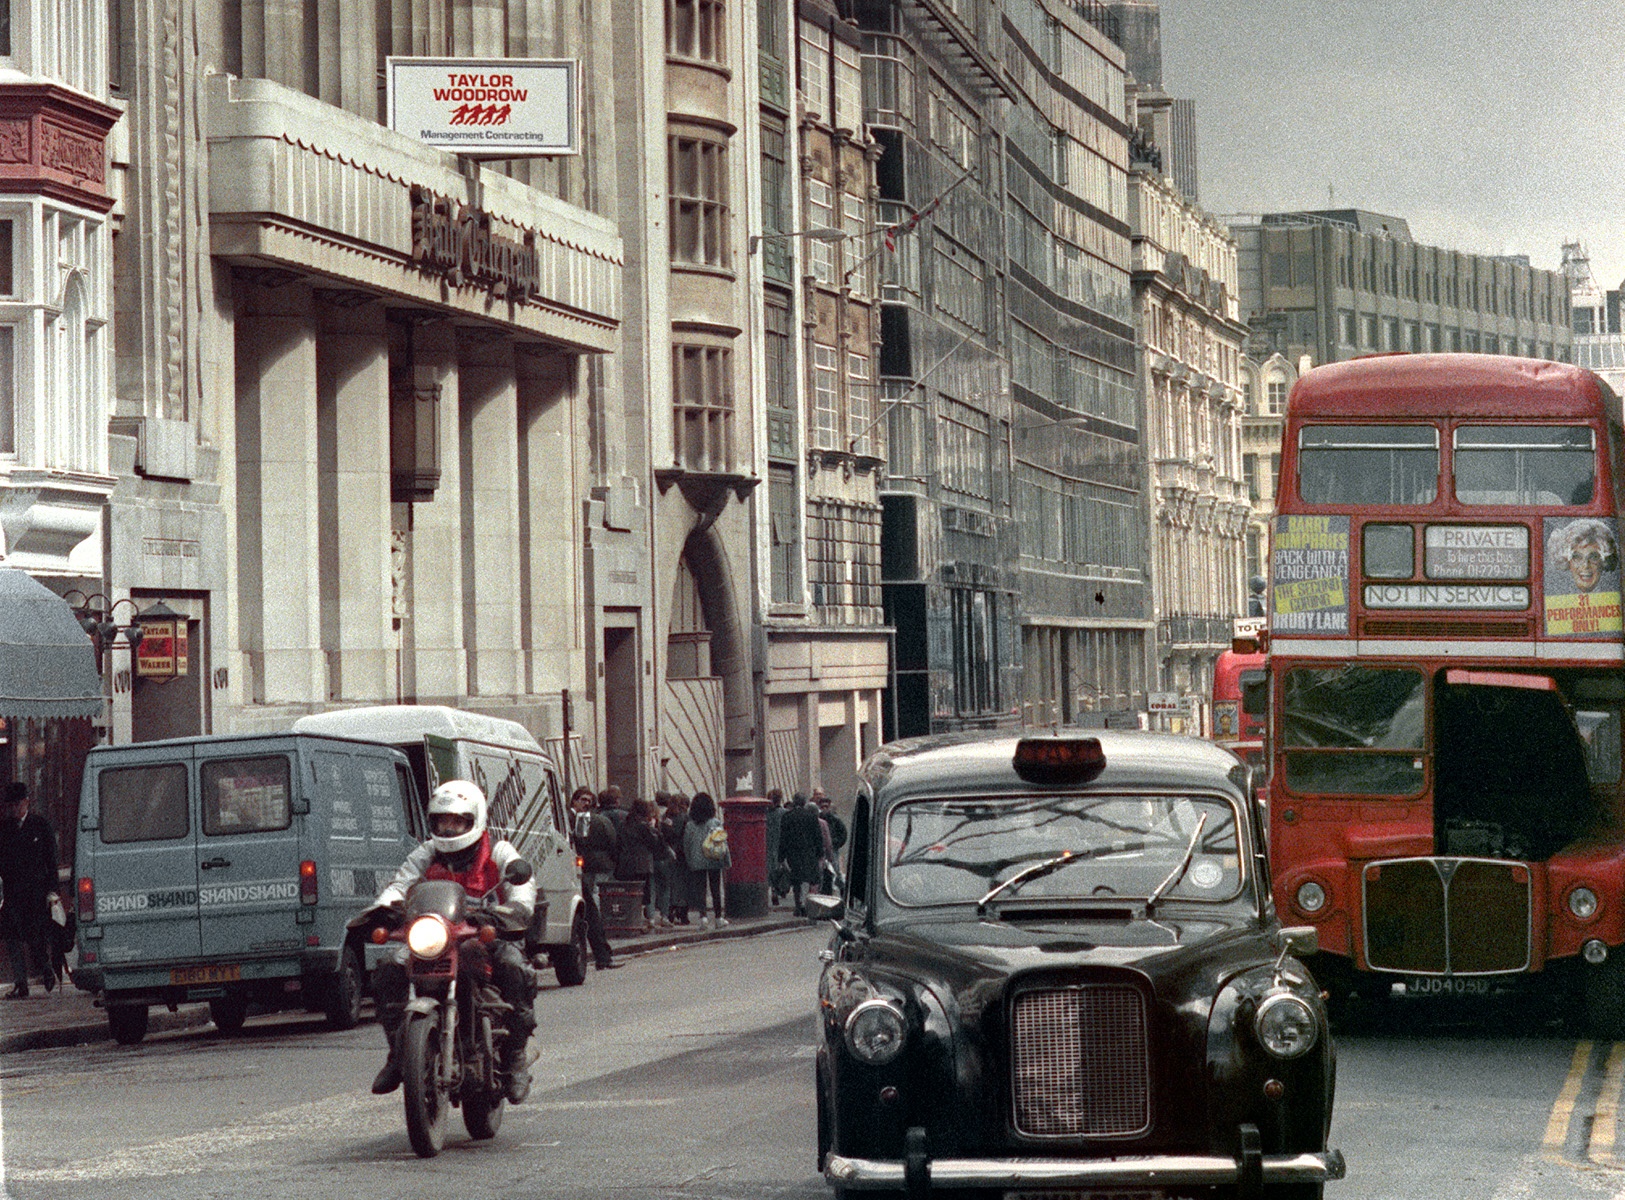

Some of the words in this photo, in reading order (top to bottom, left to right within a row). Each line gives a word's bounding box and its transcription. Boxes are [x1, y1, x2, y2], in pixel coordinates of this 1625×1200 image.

[448, 74, 513, 87] TAYLOR
[433, 88, 528, 102] WOODROW
[420, 130, 484, 141] Management
[485, 131, 544, 142] Contracting
[1288, 516, 1330, 533] BARRY
[1444, 531, 1515, 547] PRIVATE
[1307, 550, 1336, 565] WITH
[1338, 550, 1348, 565] A
[1447, 550, 1457, 563] To
[1458, 550, 1476, 563] hire
[1477, 550, 1495, 563] this
[1275, 564, 1348, 579] VENGEANCE!
[1433, 564, 1464, 577] Phone
[1369, 586, 1411, 603] NOT
[1419, 586, 1439, 603] IN
[1445, 586, 1524, 603] SERVICE
[1547, 605, 1620, 621] PERFORMANCES
[1273, 612, 1314, 629] DRURY
[1316, 612, 1347, 629] LANE
[1572, 619, 1600, 632] ONLY!
[141, 625, 169, 635] TAYLOR
[140, 659, 171, 669] WALKER
